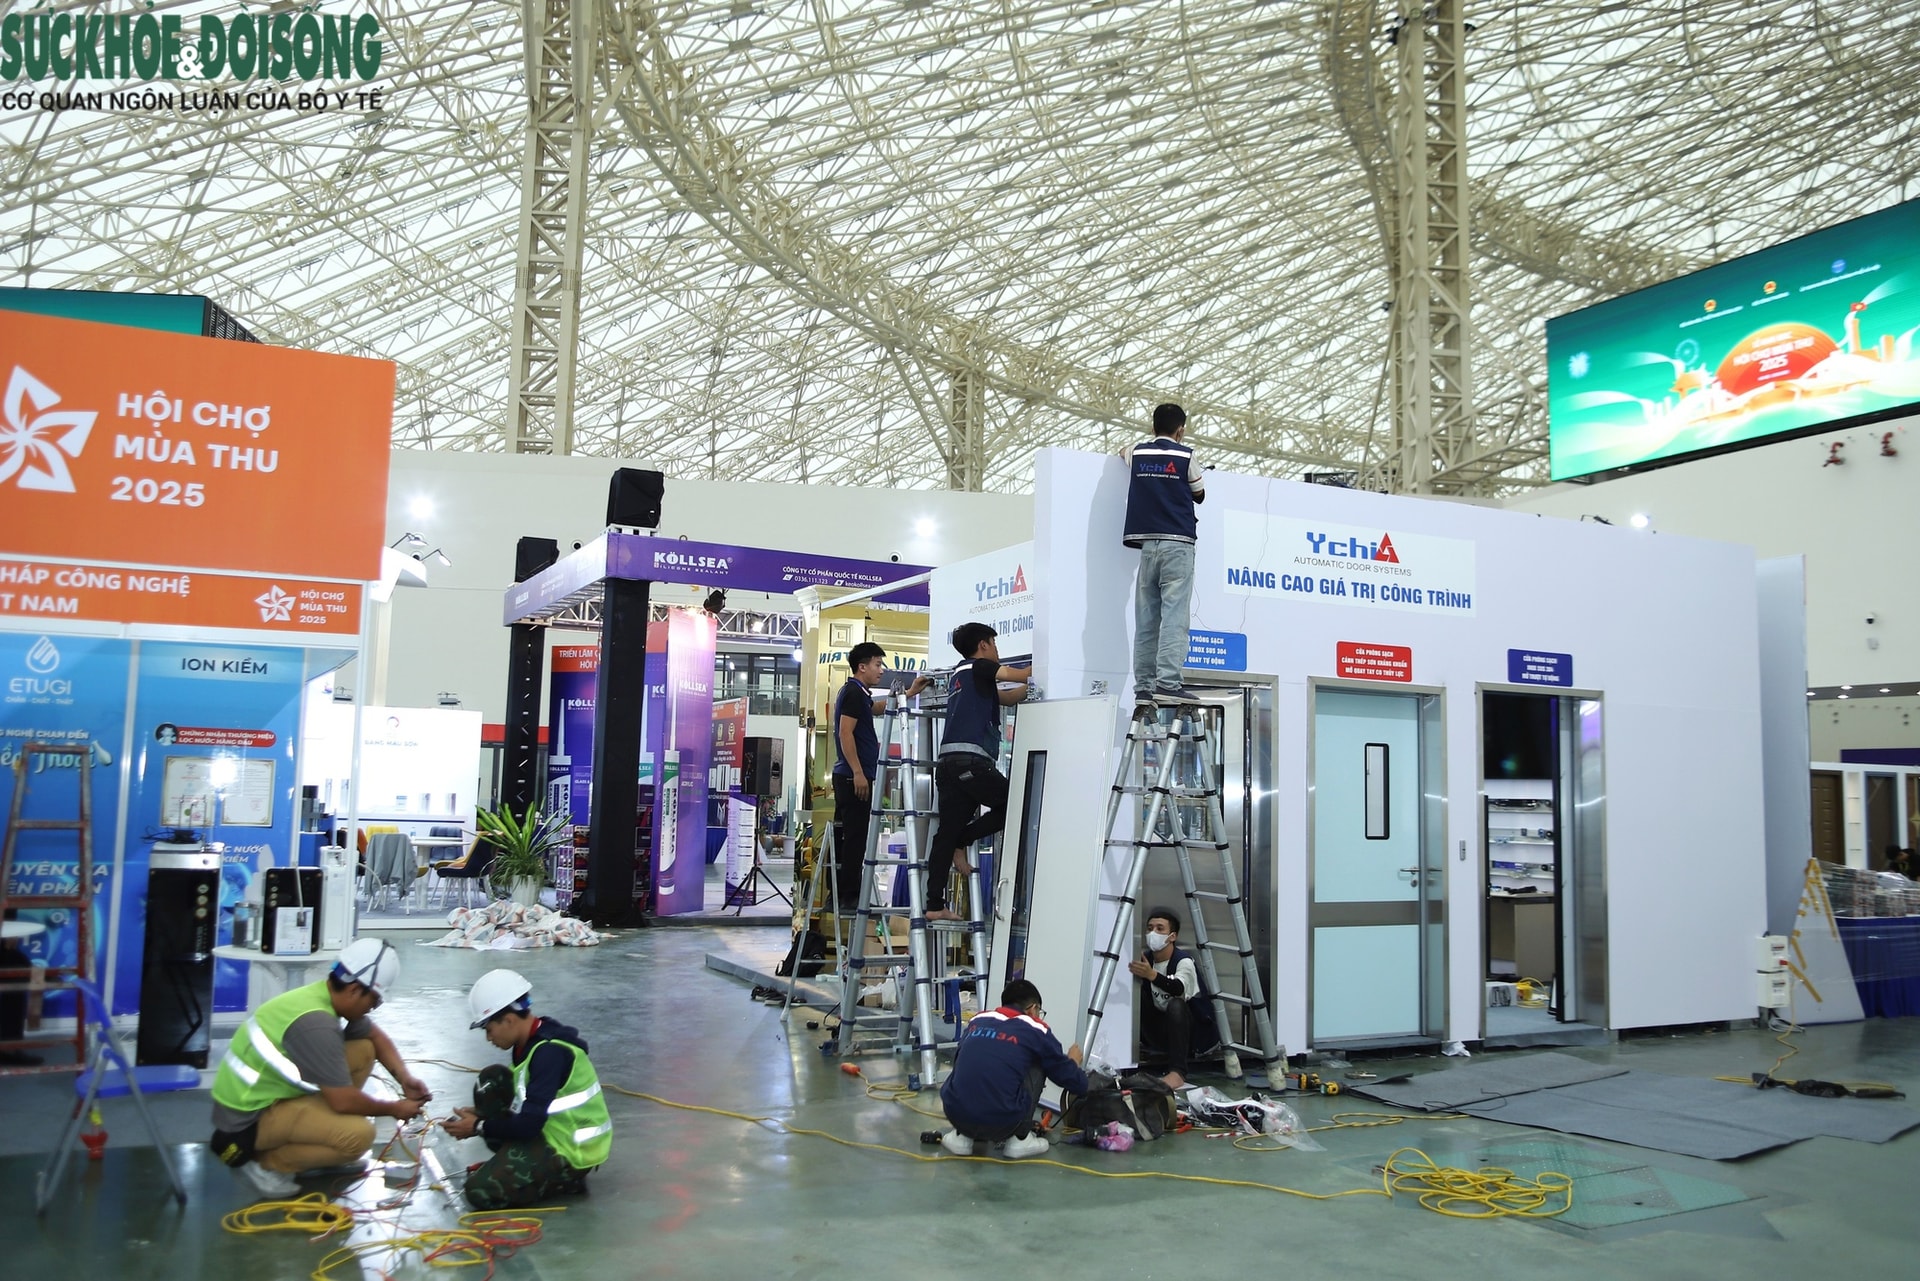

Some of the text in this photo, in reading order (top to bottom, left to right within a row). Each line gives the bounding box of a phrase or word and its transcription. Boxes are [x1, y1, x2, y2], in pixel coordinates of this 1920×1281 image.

[118, 390, 271, 438] HỘI CHỢ
[114, 430, 279, 473] MÙA THU
[111, 476, 205, 507] 2025
[783, 566, 800, 574] CÔNG
[1294, 556, 1412, 577] AUTOMATIC DOOR SYSTEMS
[0, 564, 191, 598] HÁP CÔNG NGHỆ
[1227, 566, 1471, 609] NÂNG CAO GIÁ TRỊ CÔNG TRÌNH
[21, 594, 79, 613] NAM
[301, 589, 345, 603] HỘI CHỢ
[996, 599, 1011, 611] DOOR
[300, 602, 347, 613] MÙA THU
[299, 615, 327, 624] 2025
[999, 620, 1011, 637] TRỊ
[1012, 613, 1034, 634] CÔNG
[181, 657, 269, 675] ION KIỂM
[9, 677, 72, 695] ETUGI
